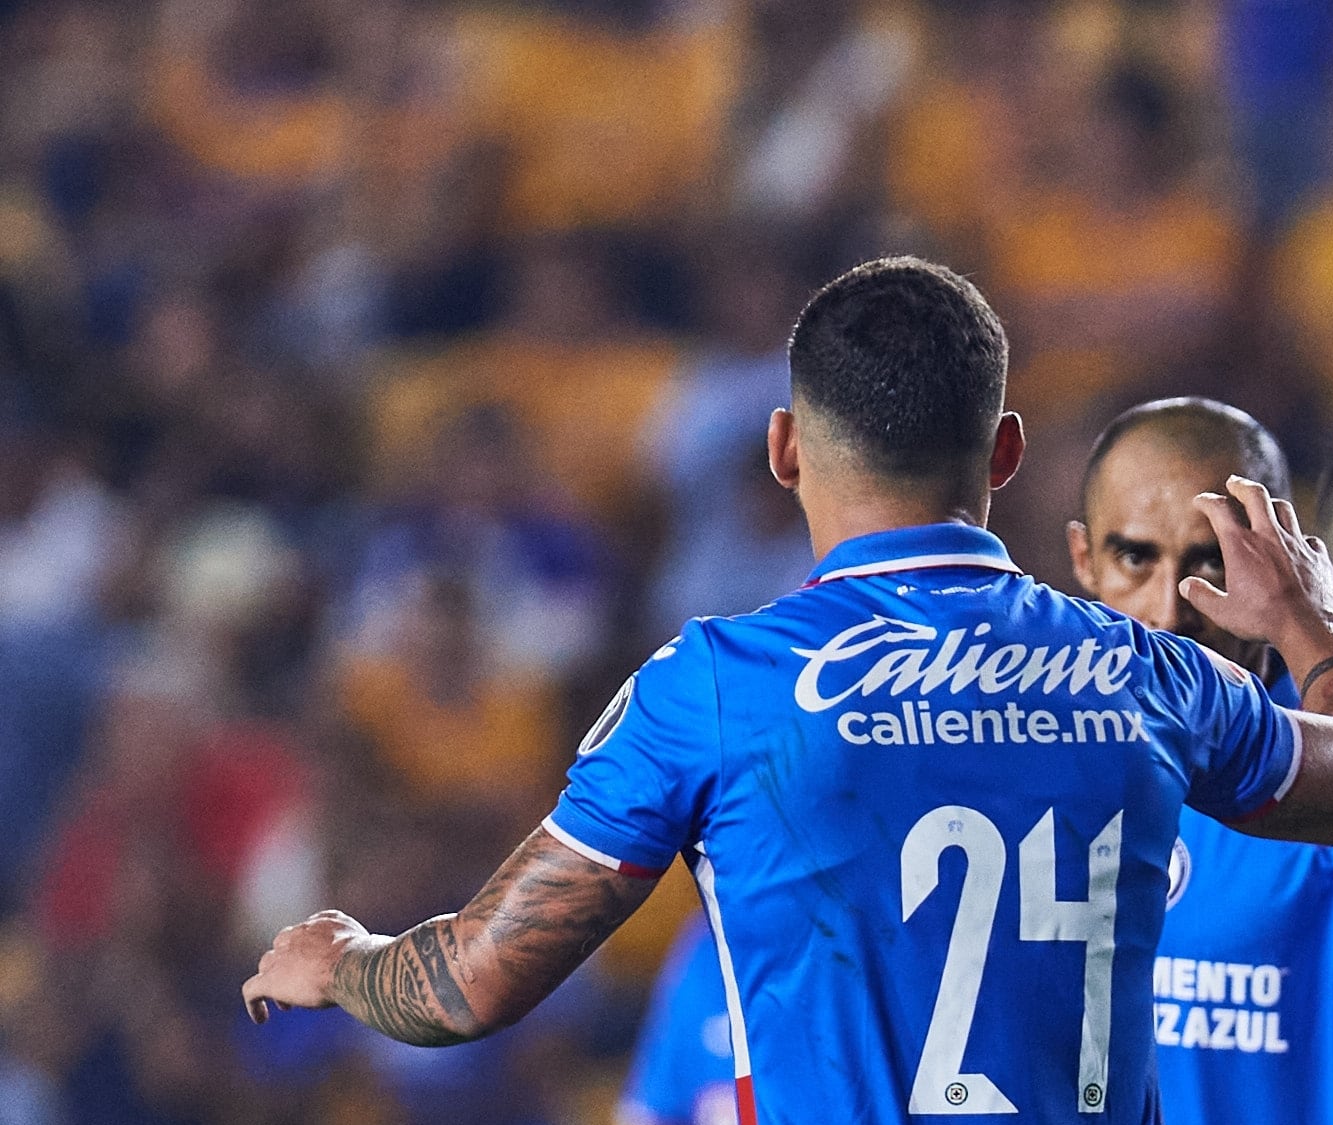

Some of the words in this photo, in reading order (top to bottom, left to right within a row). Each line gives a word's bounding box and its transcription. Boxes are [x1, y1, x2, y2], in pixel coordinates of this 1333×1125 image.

[790, 613, 1133, 713] Caliente
[837, 701, 1152, 745] caliente.mx
[901, 805, 1124, 1114] 24
